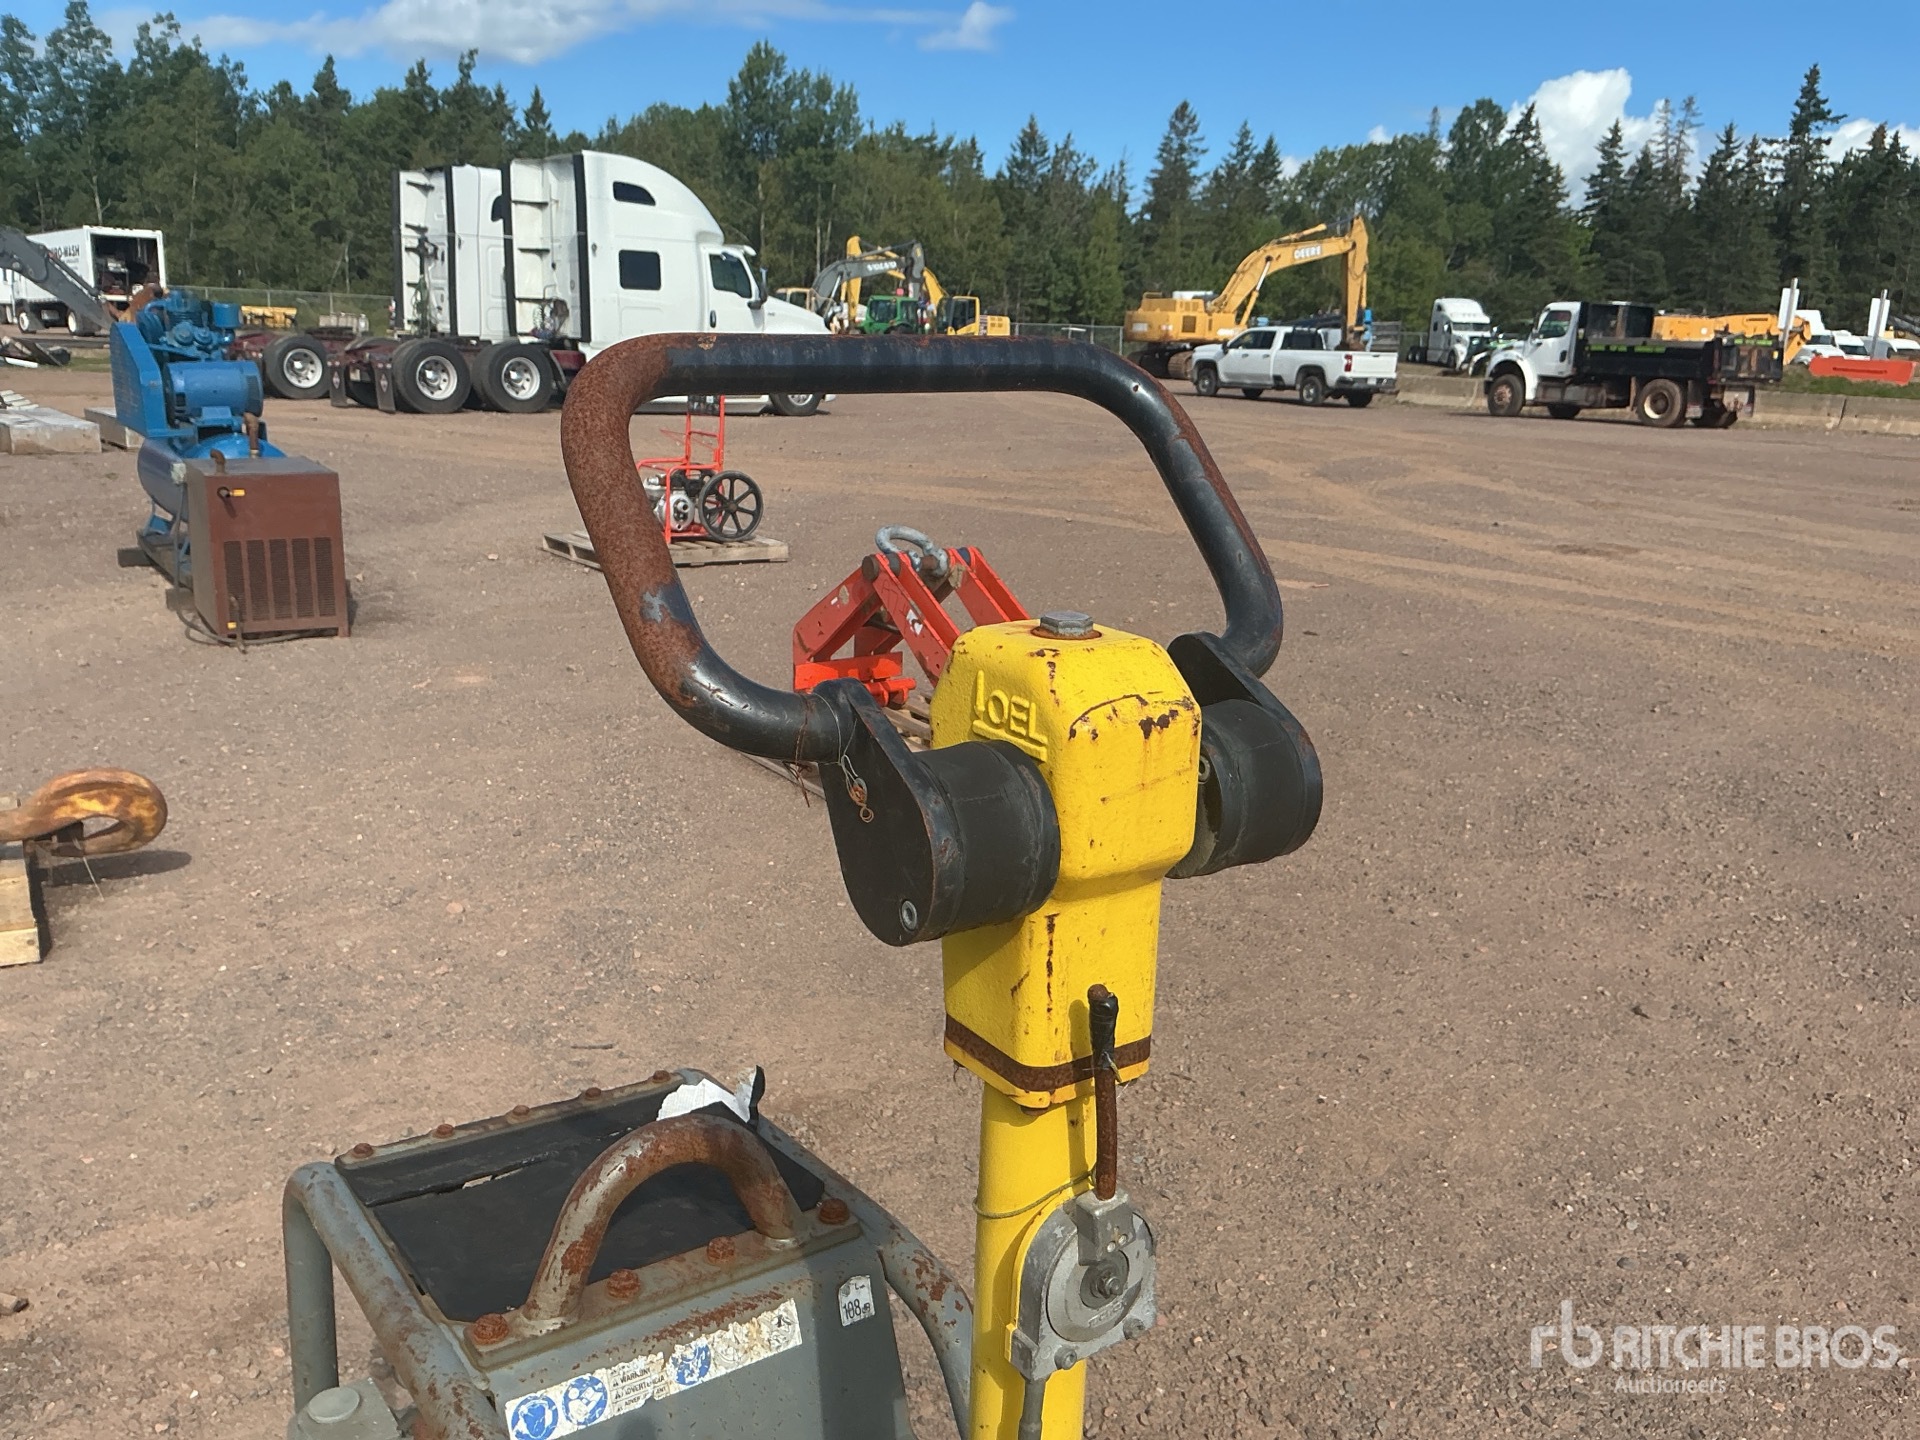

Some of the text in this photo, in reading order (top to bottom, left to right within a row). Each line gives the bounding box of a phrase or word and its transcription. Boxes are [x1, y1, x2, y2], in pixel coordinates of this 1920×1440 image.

[1294, 245, 1321, 258] DEERE
[866, 260, 897, 272] VOLVO
[842, 1298, 862, 1320] 108
